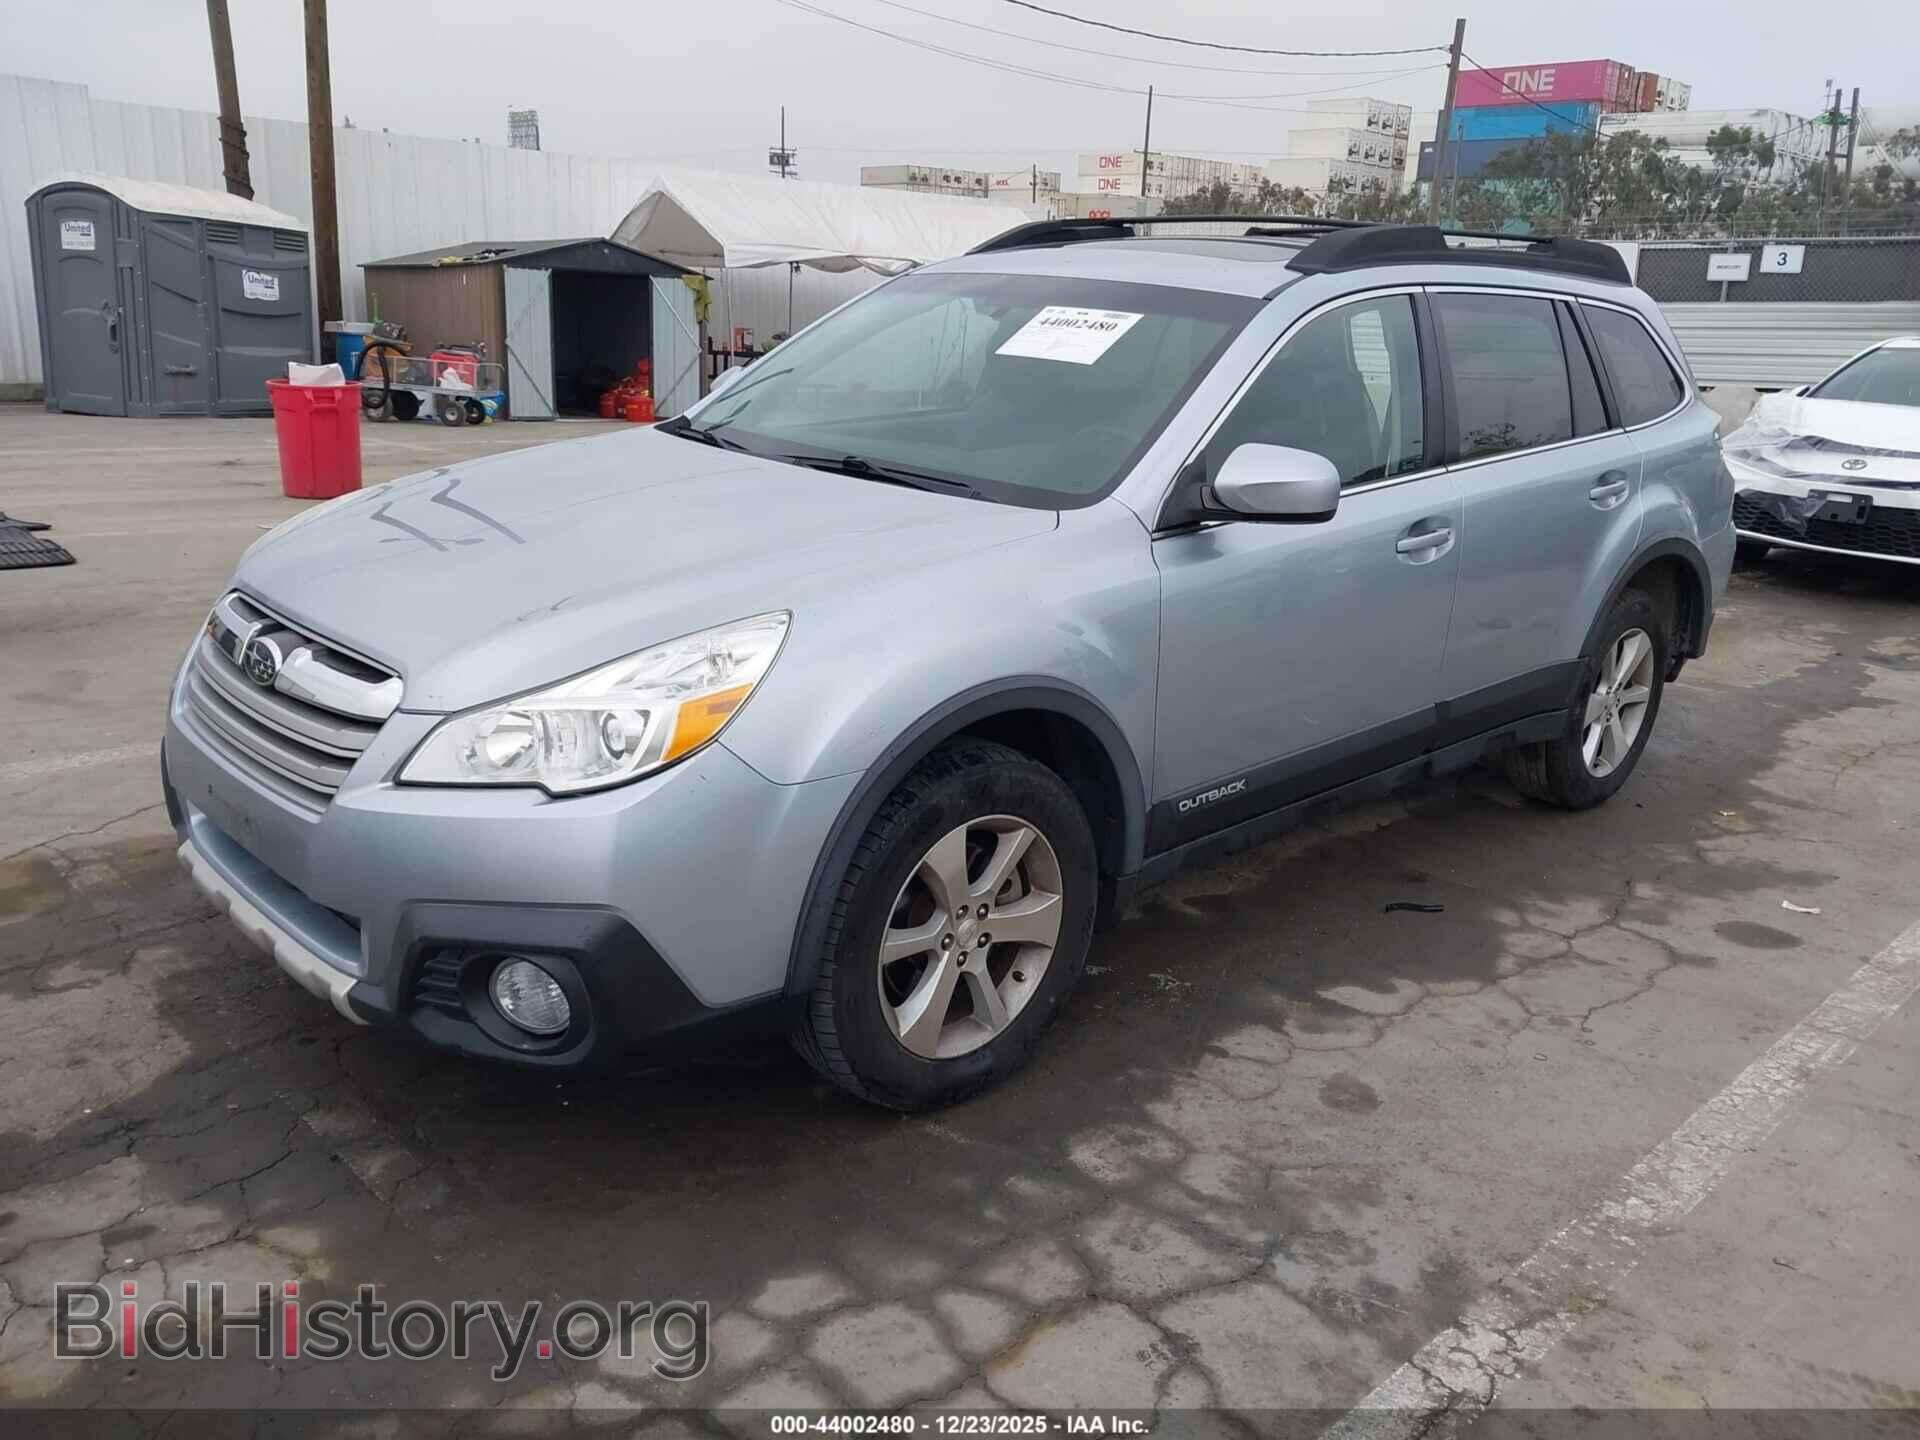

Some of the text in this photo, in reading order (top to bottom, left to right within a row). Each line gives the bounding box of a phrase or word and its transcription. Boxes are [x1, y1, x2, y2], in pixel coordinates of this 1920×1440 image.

[1501, 69, 1556, 94] ONE
[1099, 156, 1122, 169] ONE
[1098, 178, 1121, 190] ONE
[1776, 252, 1789, 266] 3
[1039, 316, 1119, 332] 44002480
[1178, 778, 1246, 812] OUTBACK
